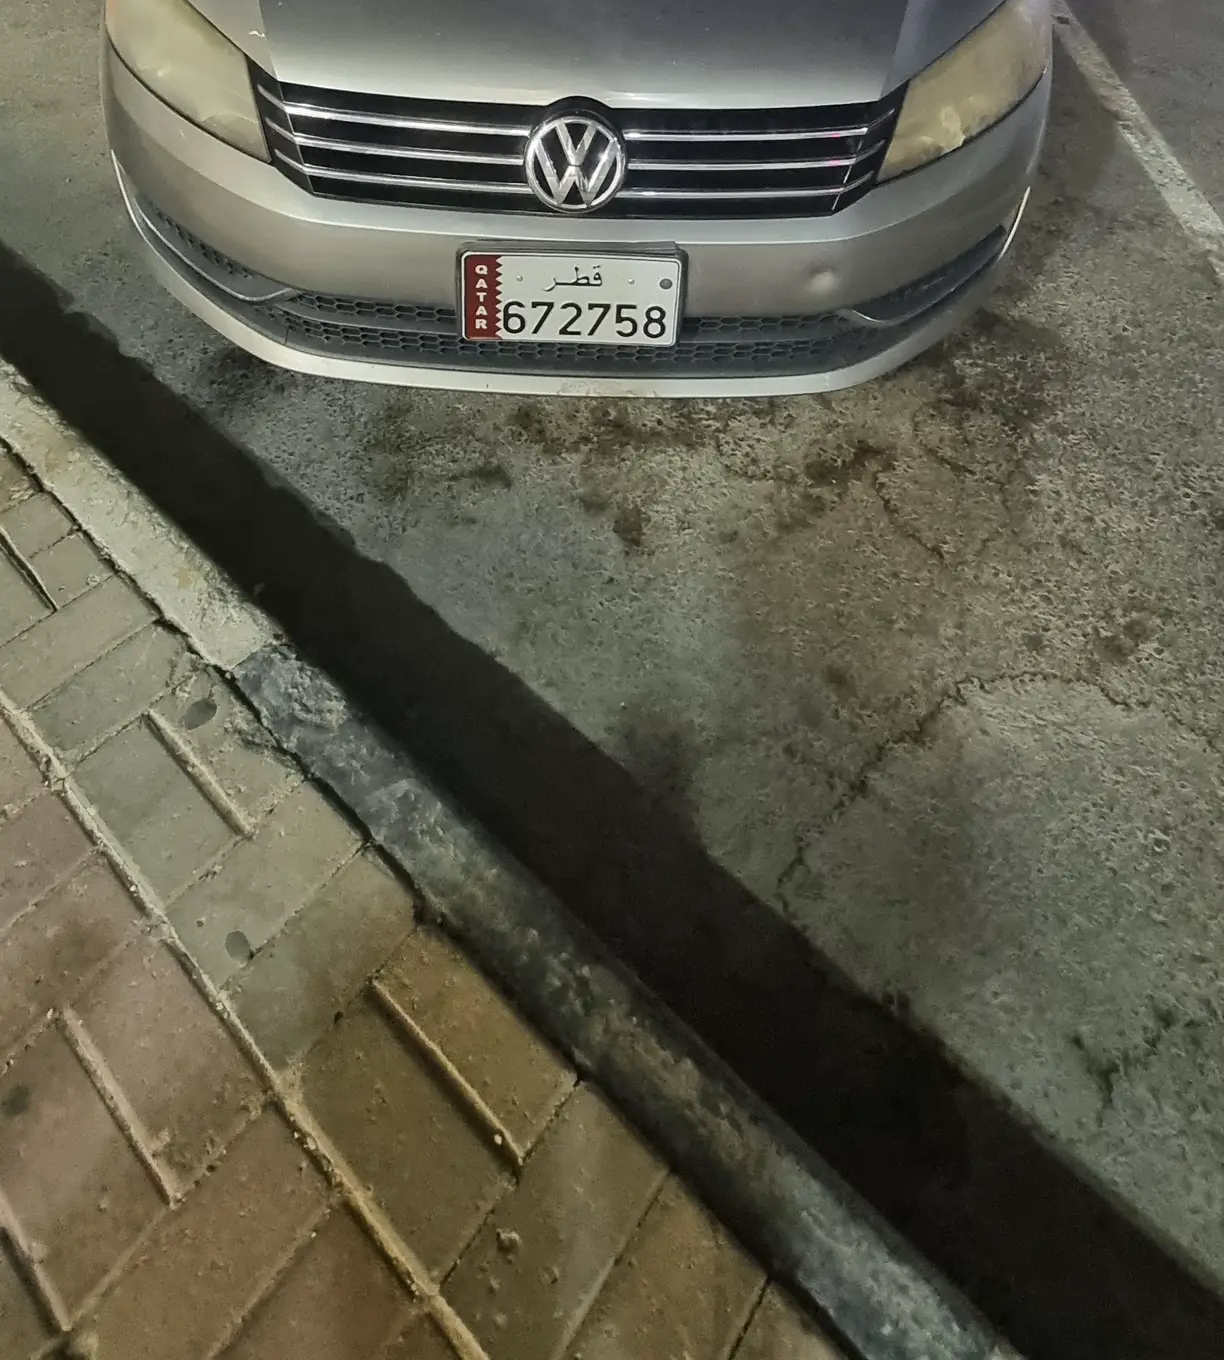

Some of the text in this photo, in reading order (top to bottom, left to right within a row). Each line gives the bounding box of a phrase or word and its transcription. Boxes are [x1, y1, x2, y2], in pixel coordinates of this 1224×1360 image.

[474, 264, 489, 330] QATAR
[542, 265, 604, 291] قطر
[502, 299, 667, 339] 672758
